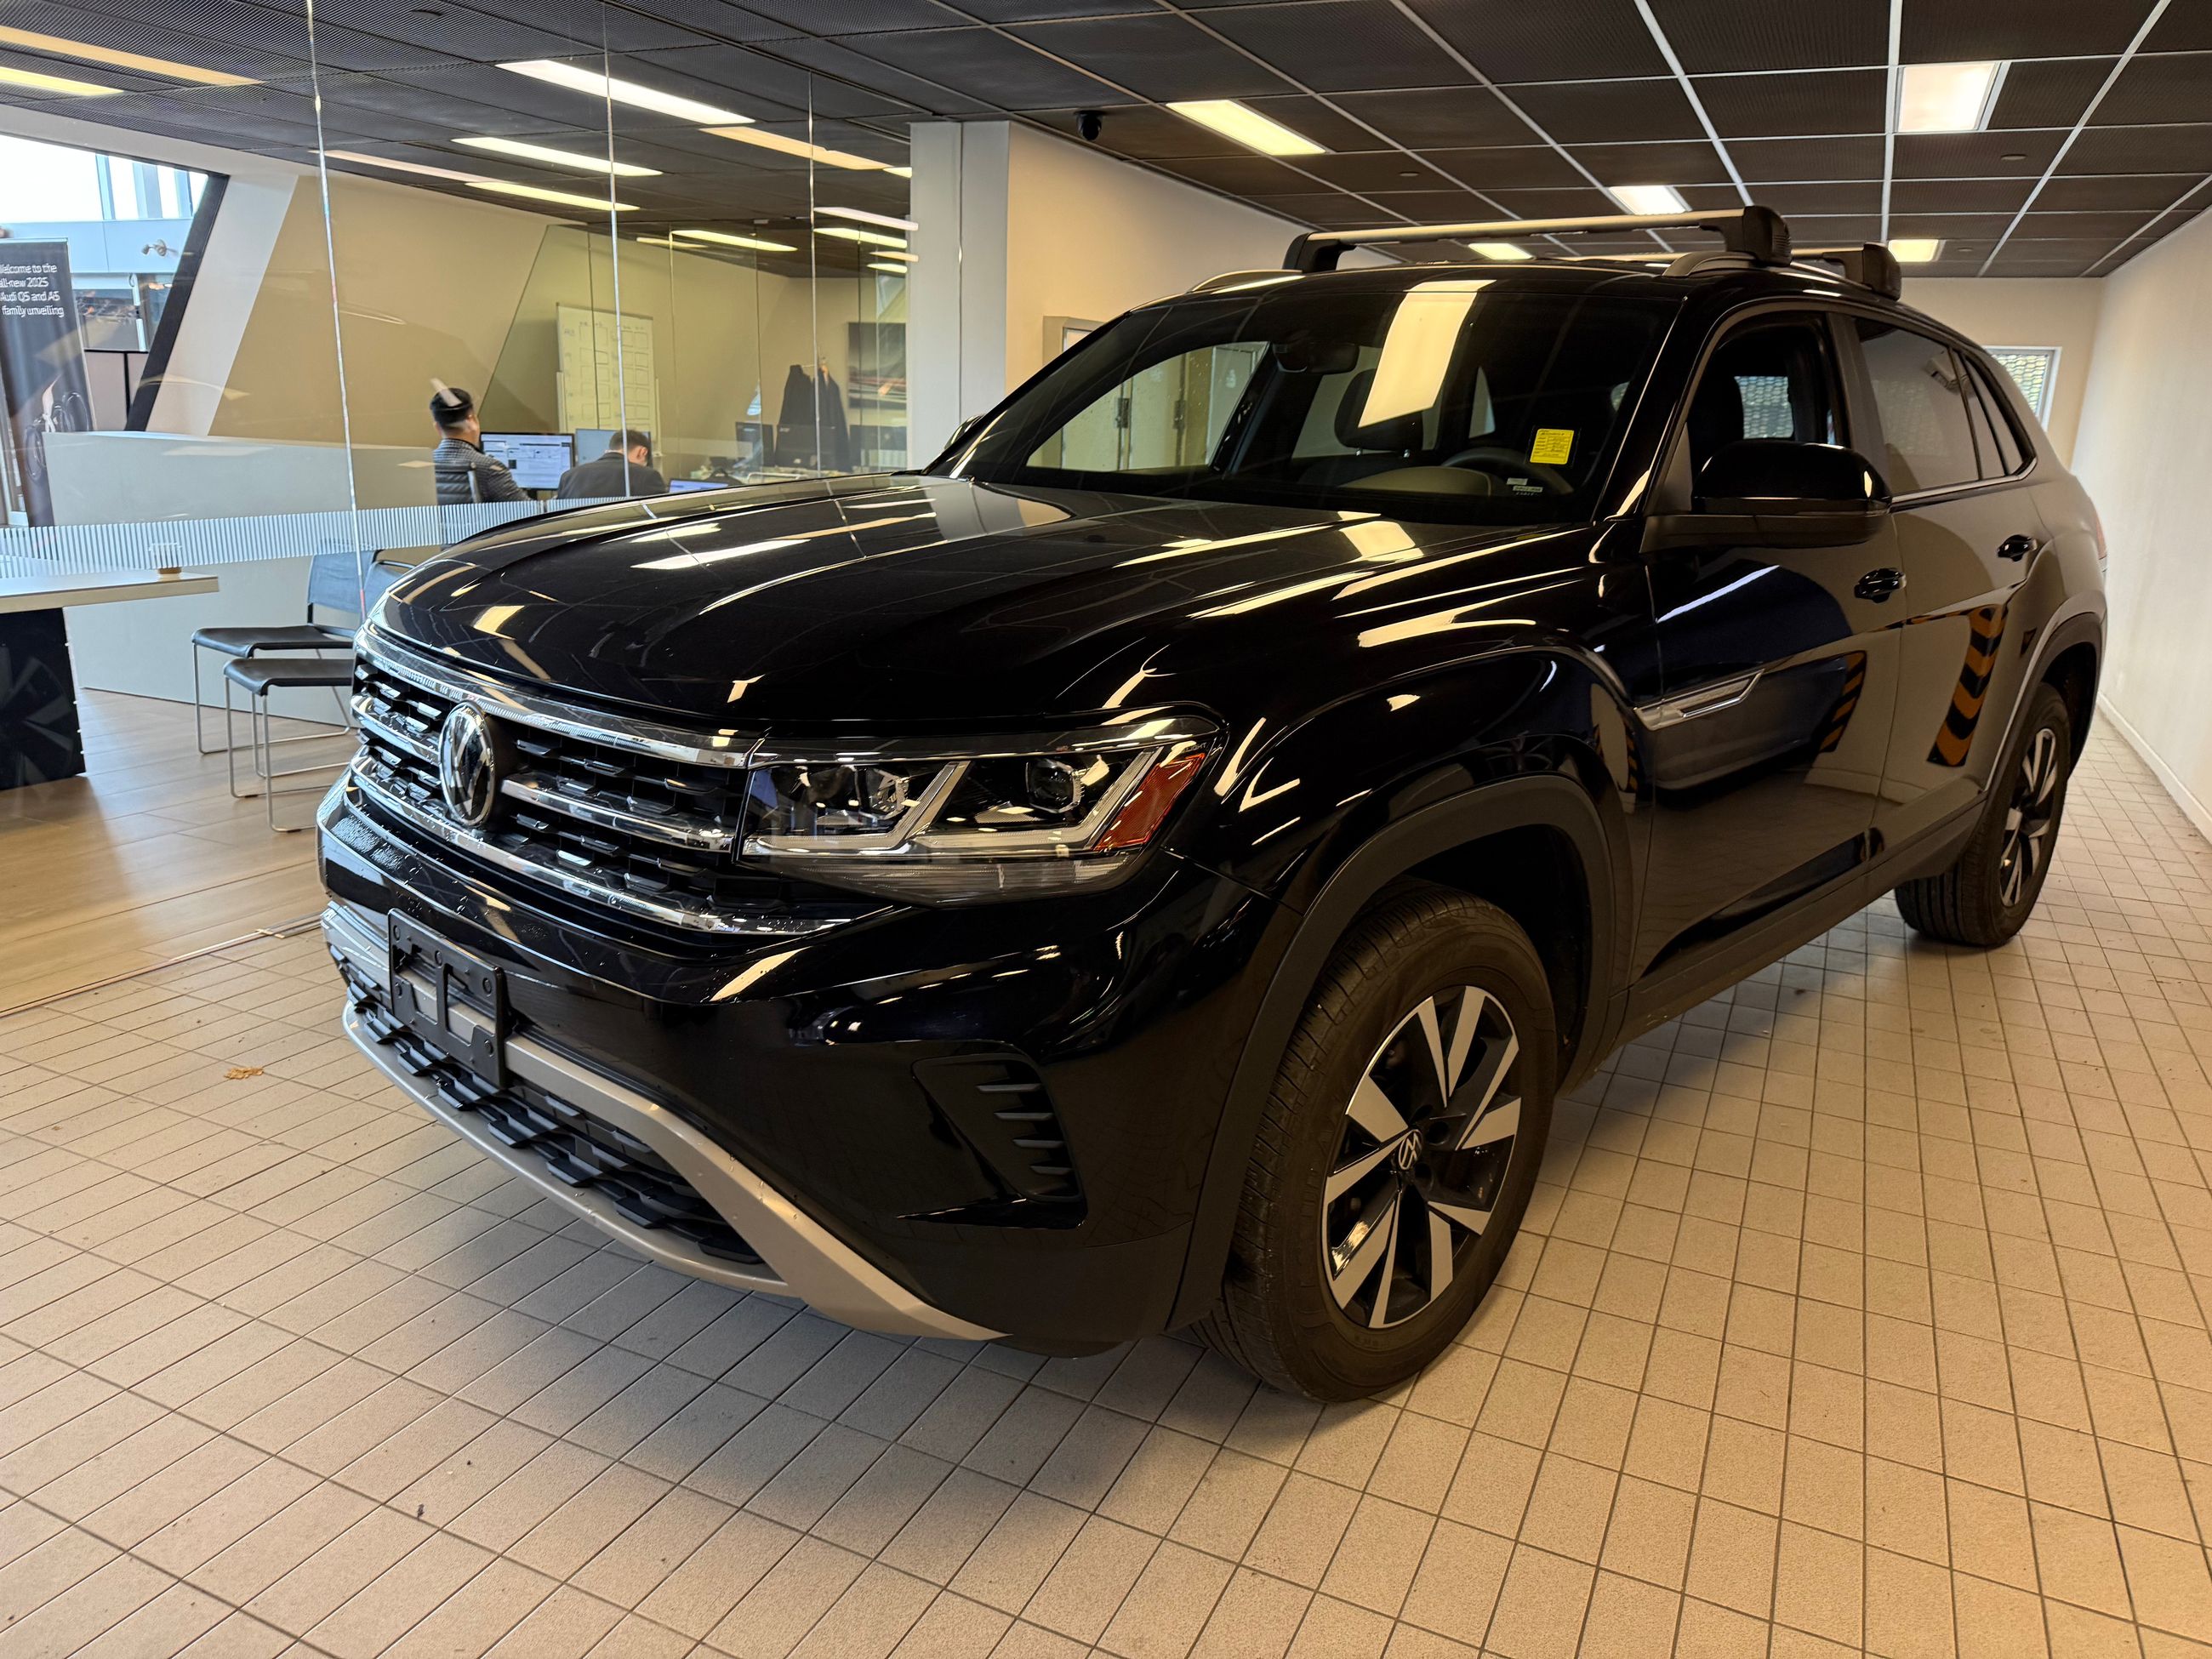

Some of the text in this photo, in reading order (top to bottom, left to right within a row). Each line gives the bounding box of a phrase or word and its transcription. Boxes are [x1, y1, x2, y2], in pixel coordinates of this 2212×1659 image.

[31, 264, 43, 273] to
[43, 263, 58, 273] the
[26, 276, 49, 288] 2025
[0, 291, 17, 301] Audi
[17, 291, 31, 303] Q5
[31, 291, 47, 301] and
[2, 305, 65, 318] family unveiling
